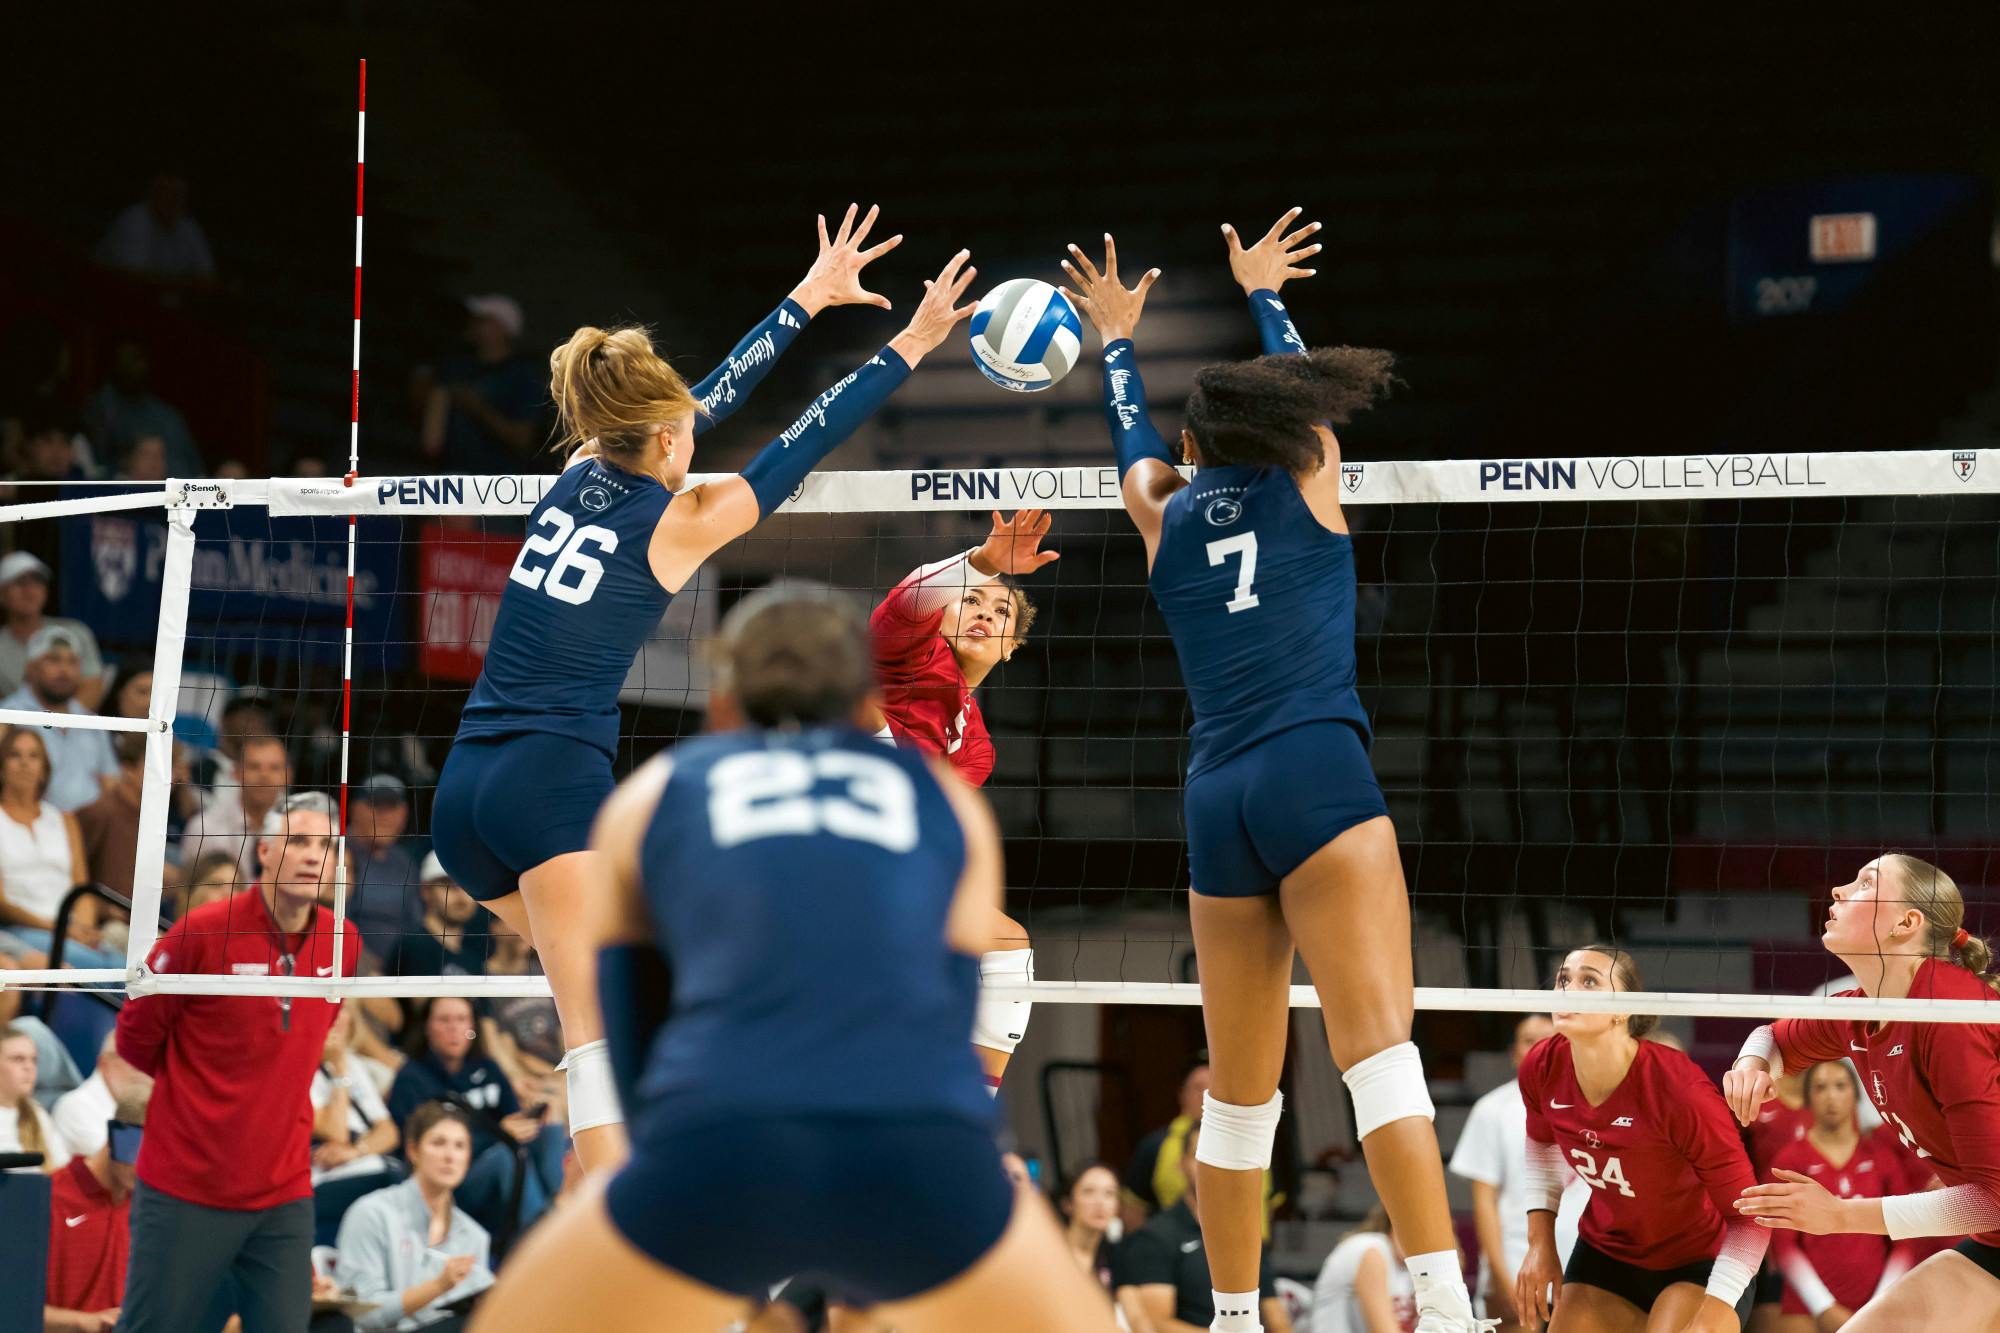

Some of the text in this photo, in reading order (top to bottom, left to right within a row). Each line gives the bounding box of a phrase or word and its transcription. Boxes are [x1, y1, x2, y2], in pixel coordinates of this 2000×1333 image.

[728, 330, 775, 380] Nittany
[1109, 369, 1132, 407] Nittany
[779, 403, 825, 448] Nittany
[191, 484, 221, 493] Senoh
[378, 476, 544, 505] PENN VOLL
[911, 470, 1118, 500] PENN VOLLE
[1480, 454, 1827, 491] PENN VOLLEYBALL
[509, 506, 620, 606] 26
[1205, 530, 1260, 614] 7
[705, 750, 920, 853] 23
[1570, 1148, 1636, 1198] 24
